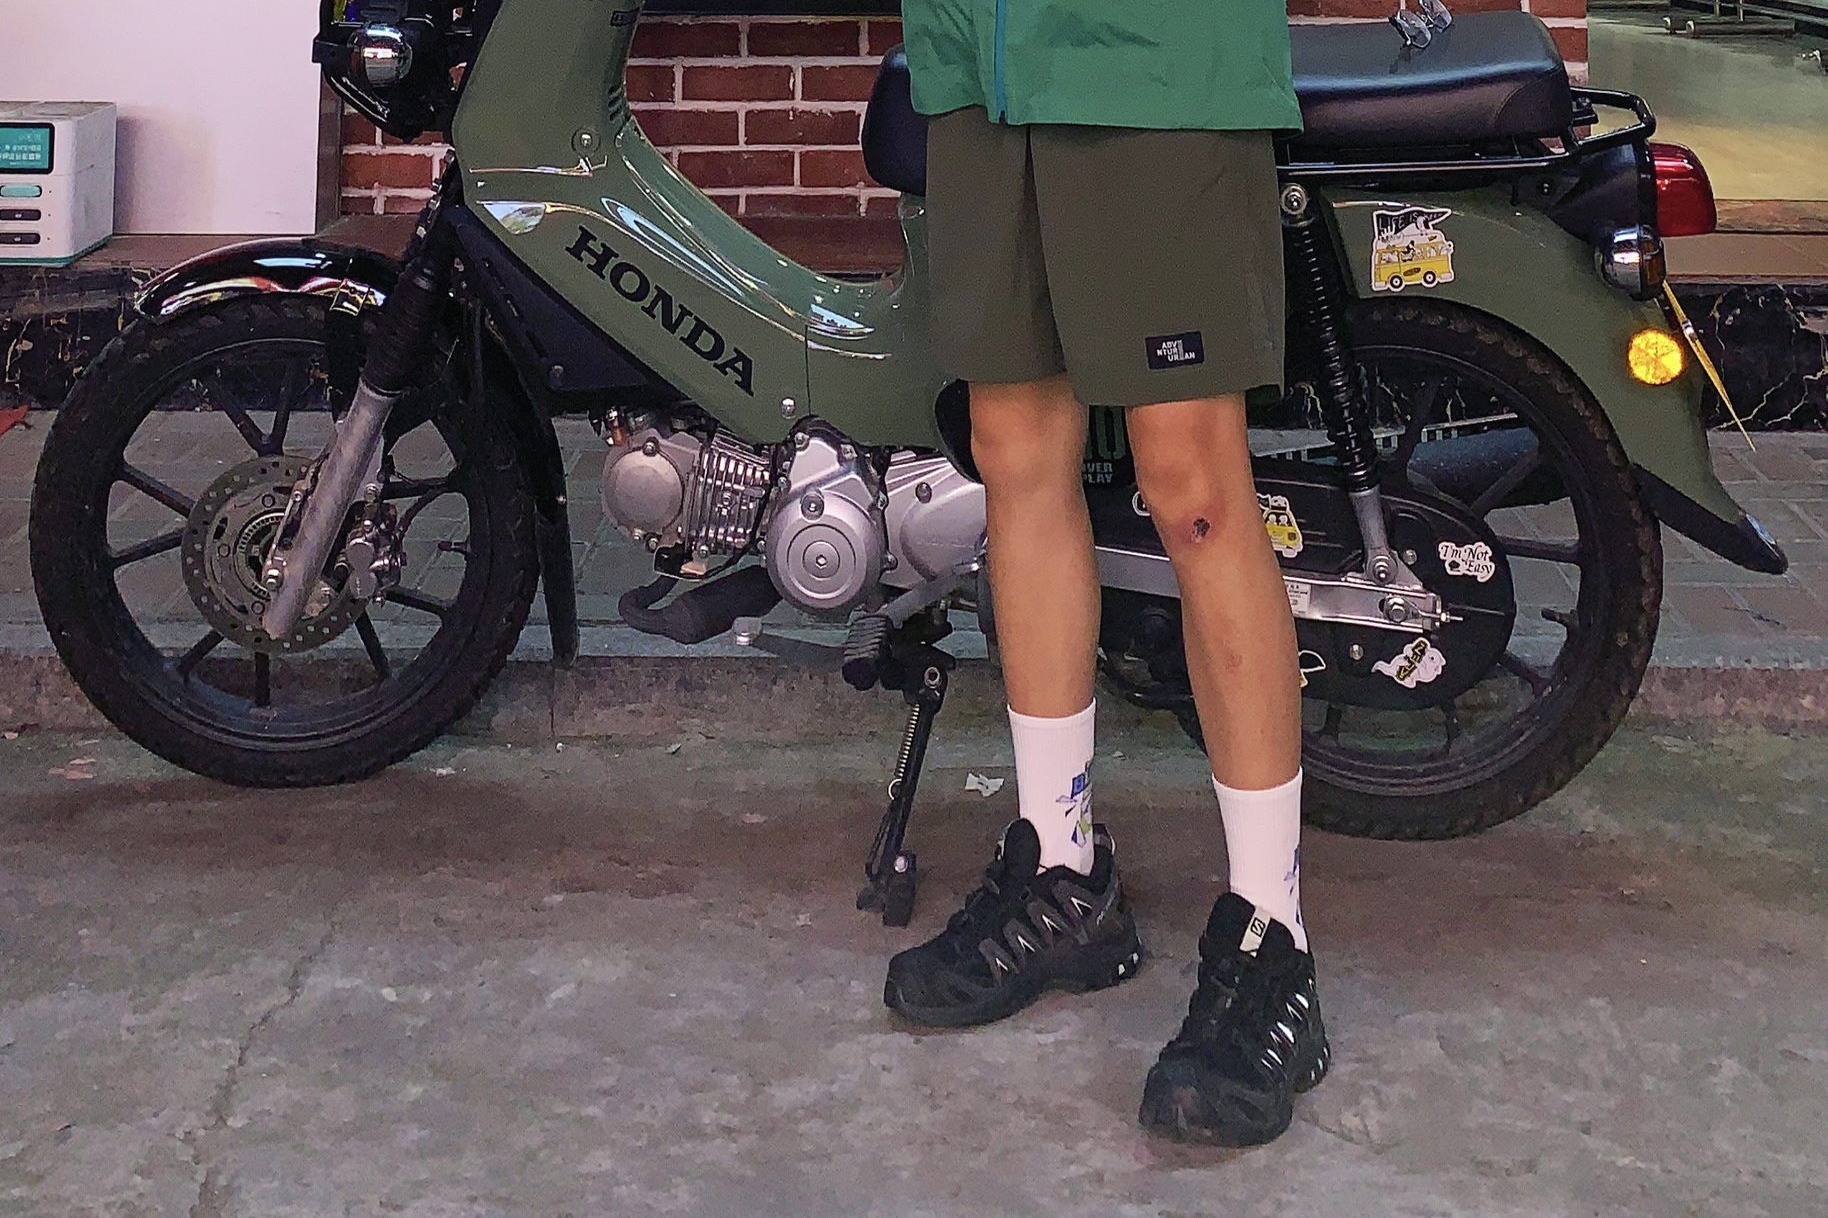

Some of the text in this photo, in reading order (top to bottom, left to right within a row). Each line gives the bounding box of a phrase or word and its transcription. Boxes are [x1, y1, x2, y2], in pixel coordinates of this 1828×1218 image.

[1379, 215, 1405, 230] LIFE
[565, 225, 754, 397] HONDA
[1441, 545, 1489, 565] I'm Not
[1466, 560, 1493, 579] Easy
